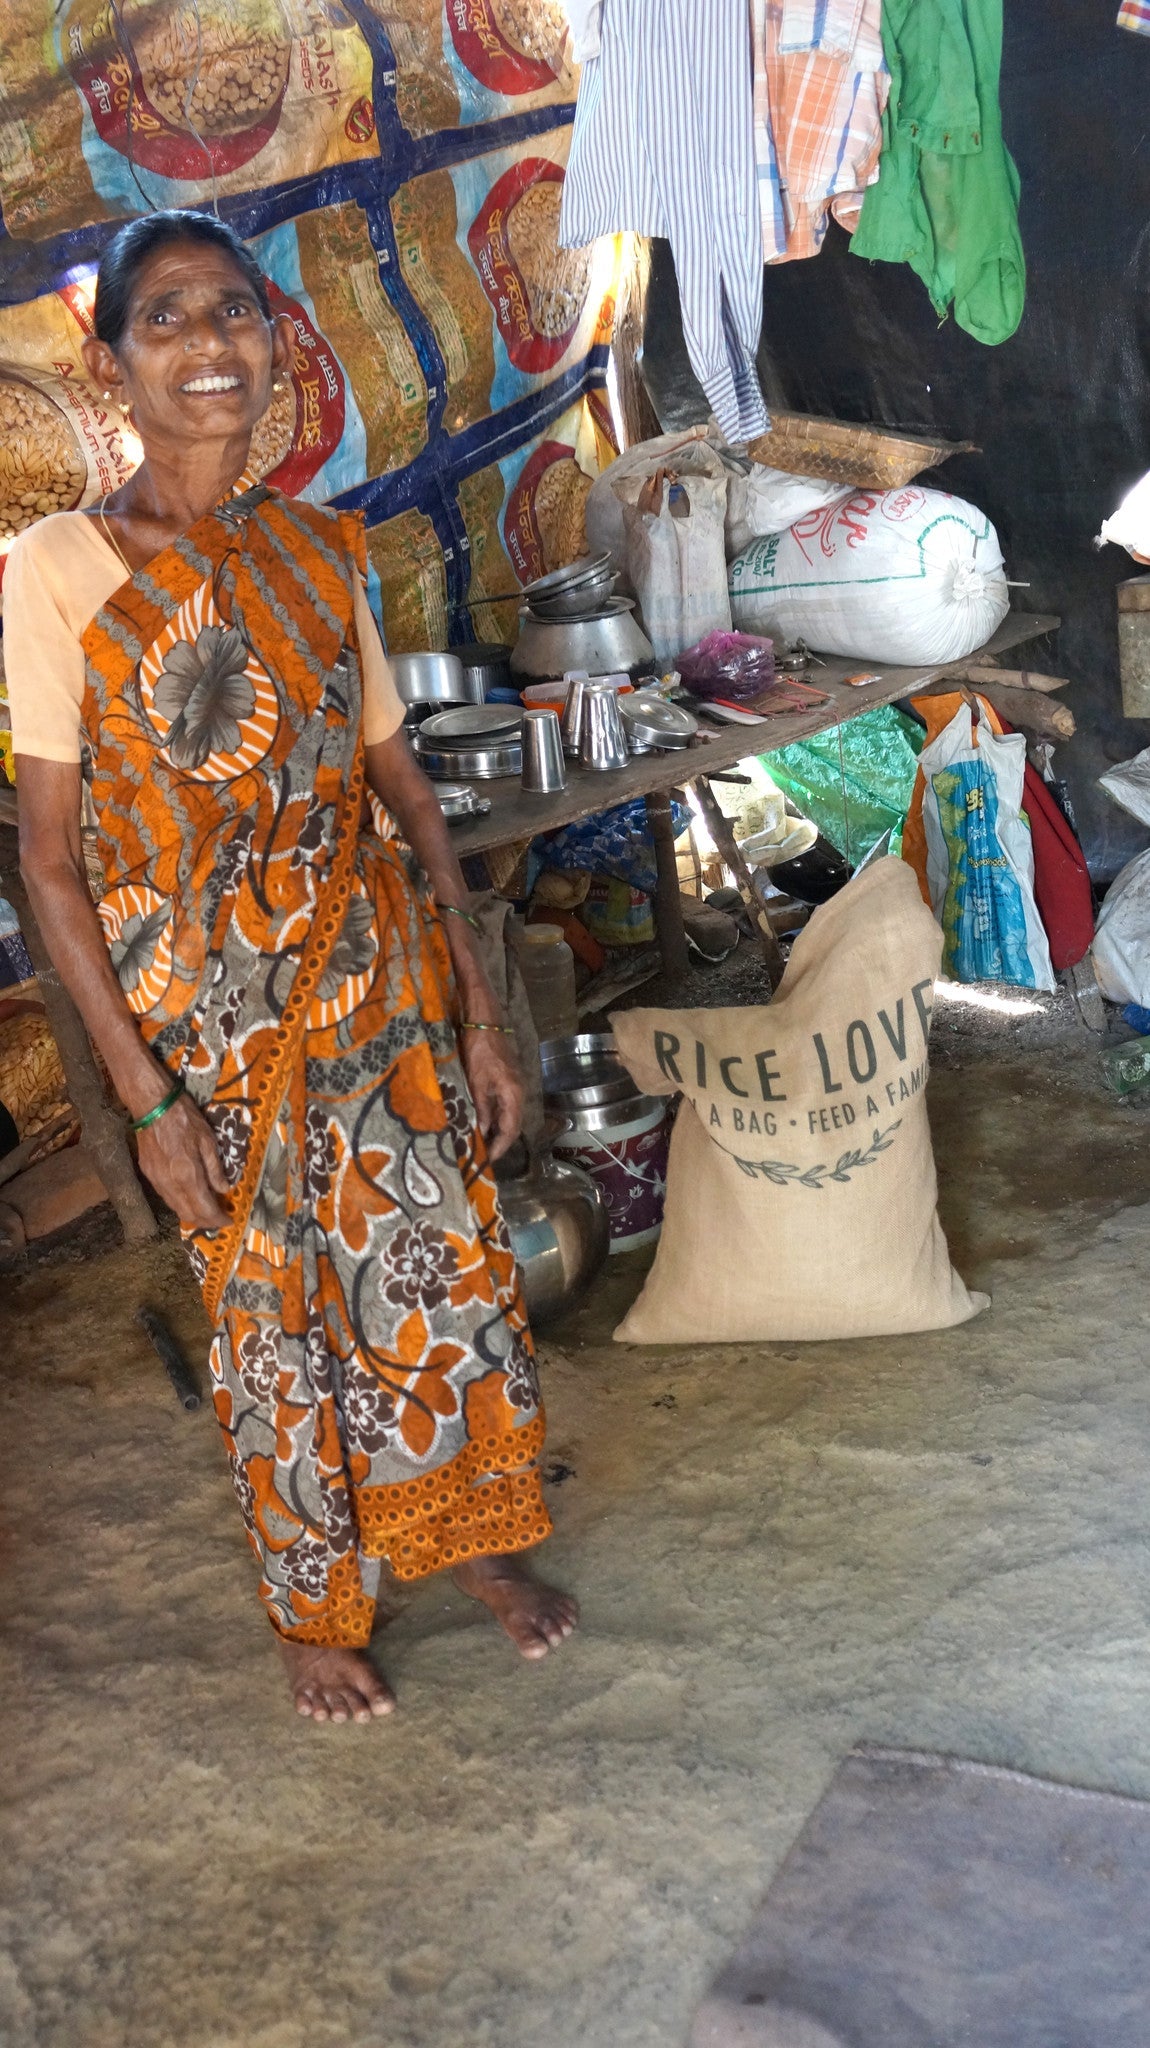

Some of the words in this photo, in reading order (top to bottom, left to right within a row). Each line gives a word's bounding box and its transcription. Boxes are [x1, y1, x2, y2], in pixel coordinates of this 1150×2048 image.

[300, 37, 315, 92] SEEDS
[763, 538, 780, 578] SALT
[654, 1030, 788, 1102] RICE
[709, 1103, 722, 1128] A
[732, 1107, 777, 1137] BAG
[808, 1104, 856, 1135] FEED
[866, 1095, 879, 1118] A
